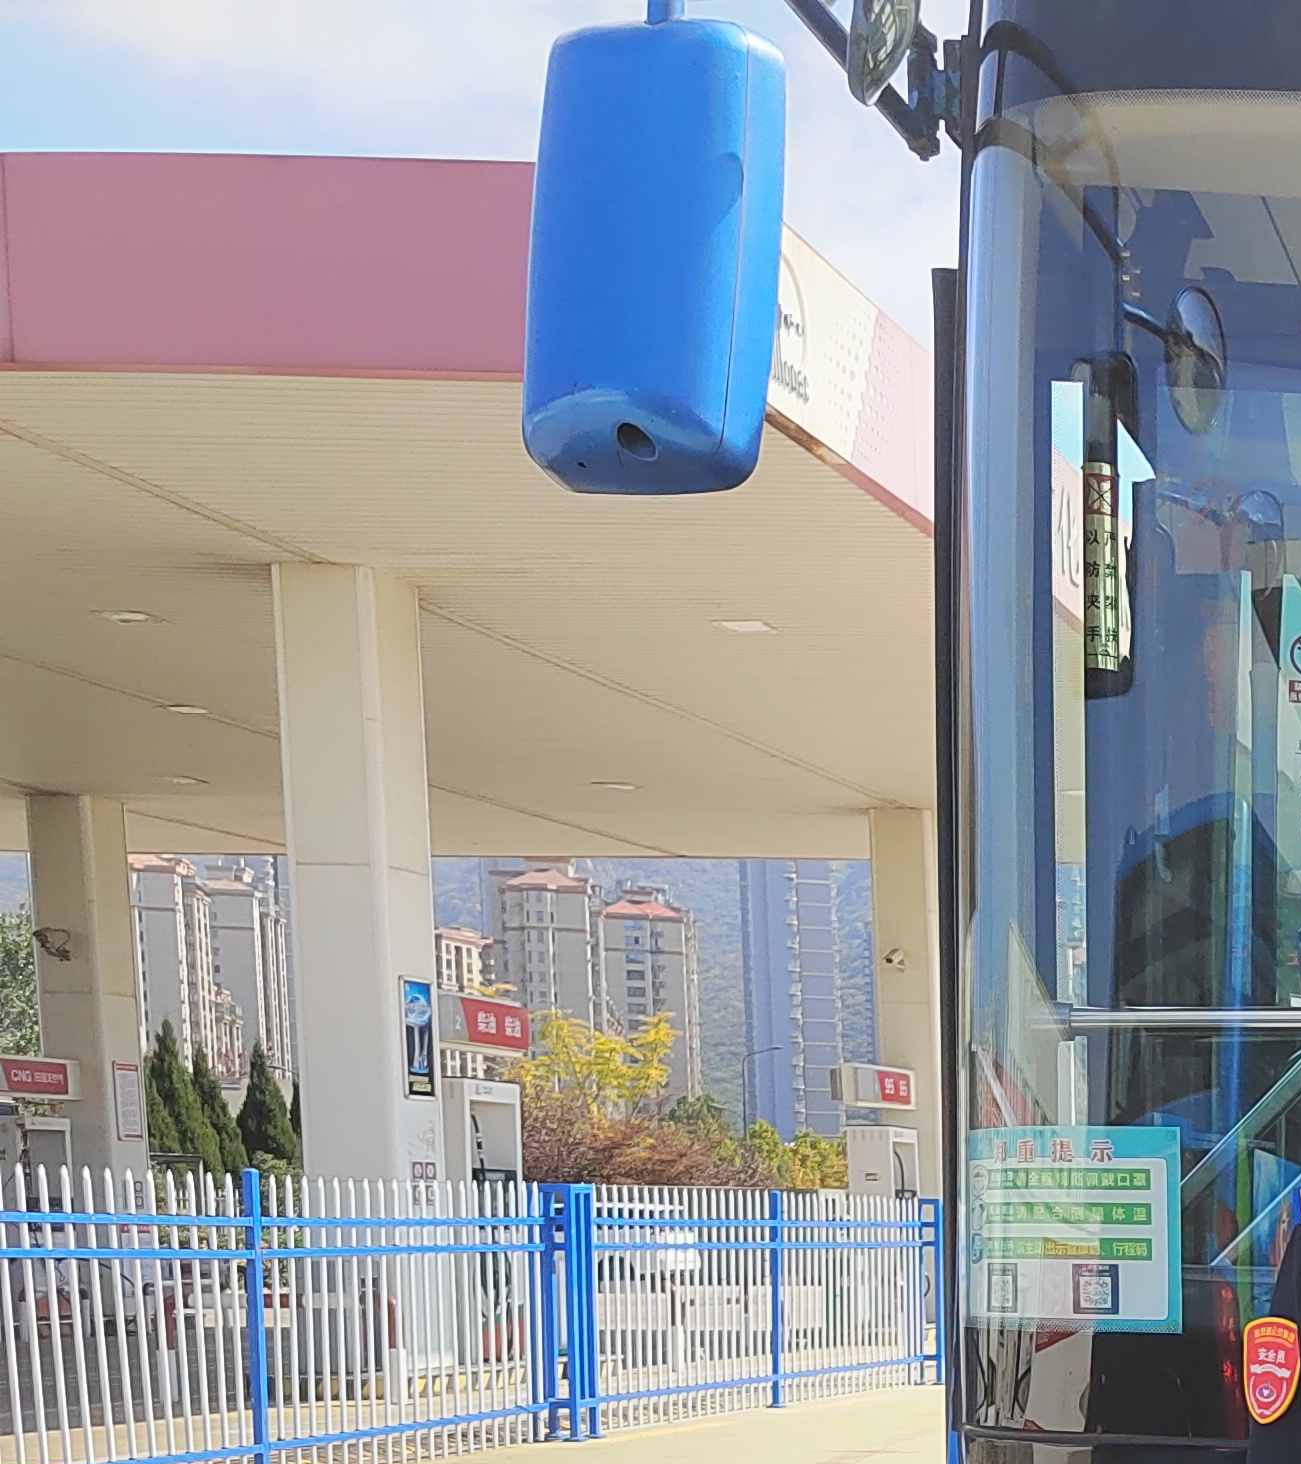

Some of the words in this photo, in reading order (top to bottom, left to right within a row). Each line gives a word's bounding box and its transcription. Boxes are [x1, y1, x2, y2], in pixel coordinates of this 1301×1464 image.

[11, 1069, 32, 1083] CNG
[993, 1138, 1115, 1164] 郑重提示
[1258, 1346, 1286, 1364] 安全员
